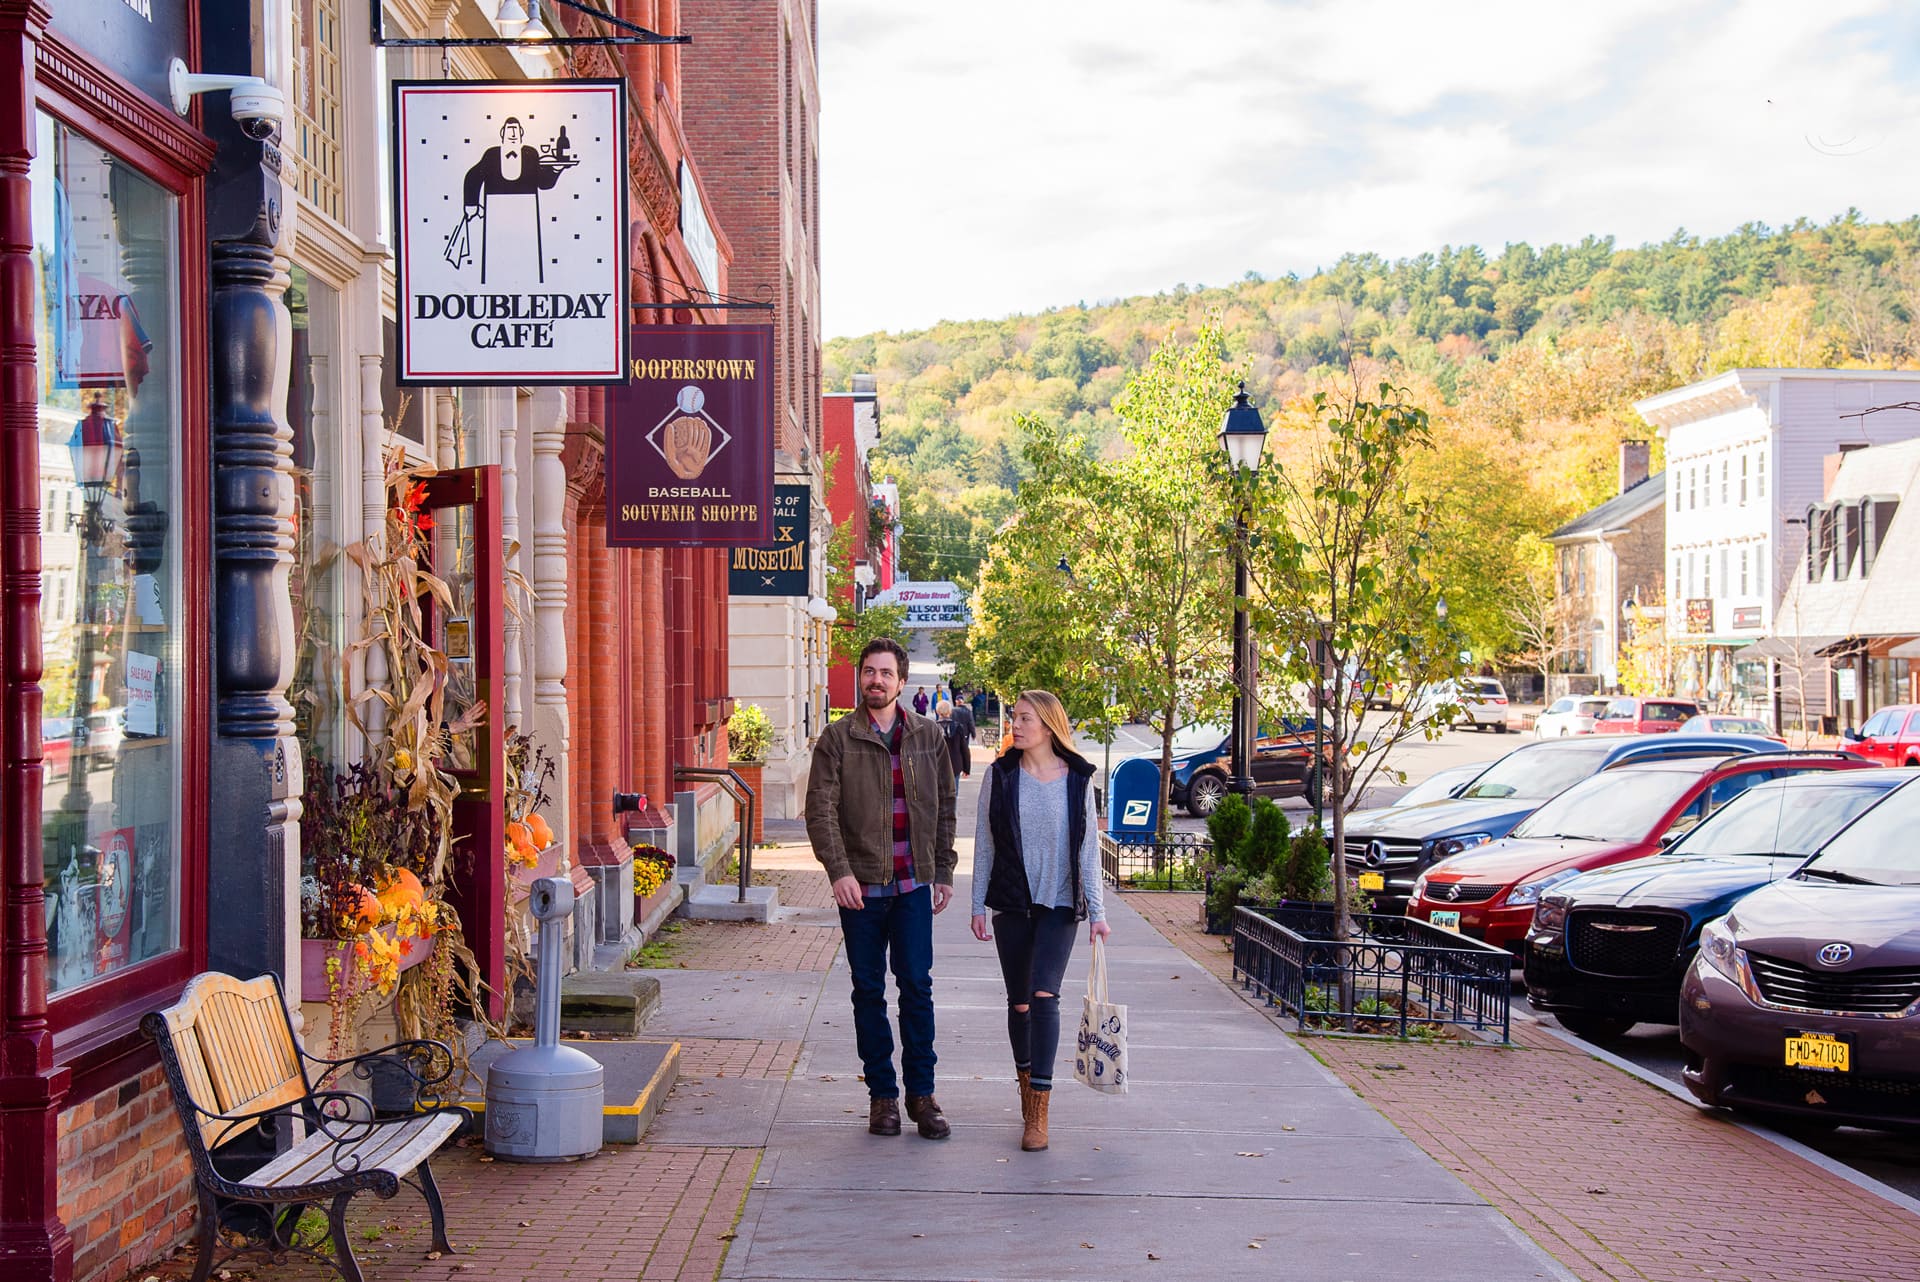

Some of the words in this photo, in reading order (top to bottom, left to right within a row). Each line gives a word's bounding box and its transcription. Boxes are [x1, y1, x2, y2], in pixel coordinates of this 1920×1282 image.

[414, 293, 611, 320] DOUBLEDAY
[470, 320, 555, 349] CAFÉ
[648, 487, 732, 498] BASEBALL
[785, 496, 800, 505] OF
[621, 504, 696, 521] SOUVENIR
[701, 504, 758, 522] SHOPPE
[732, 540, 805, 571] MUSEUM
